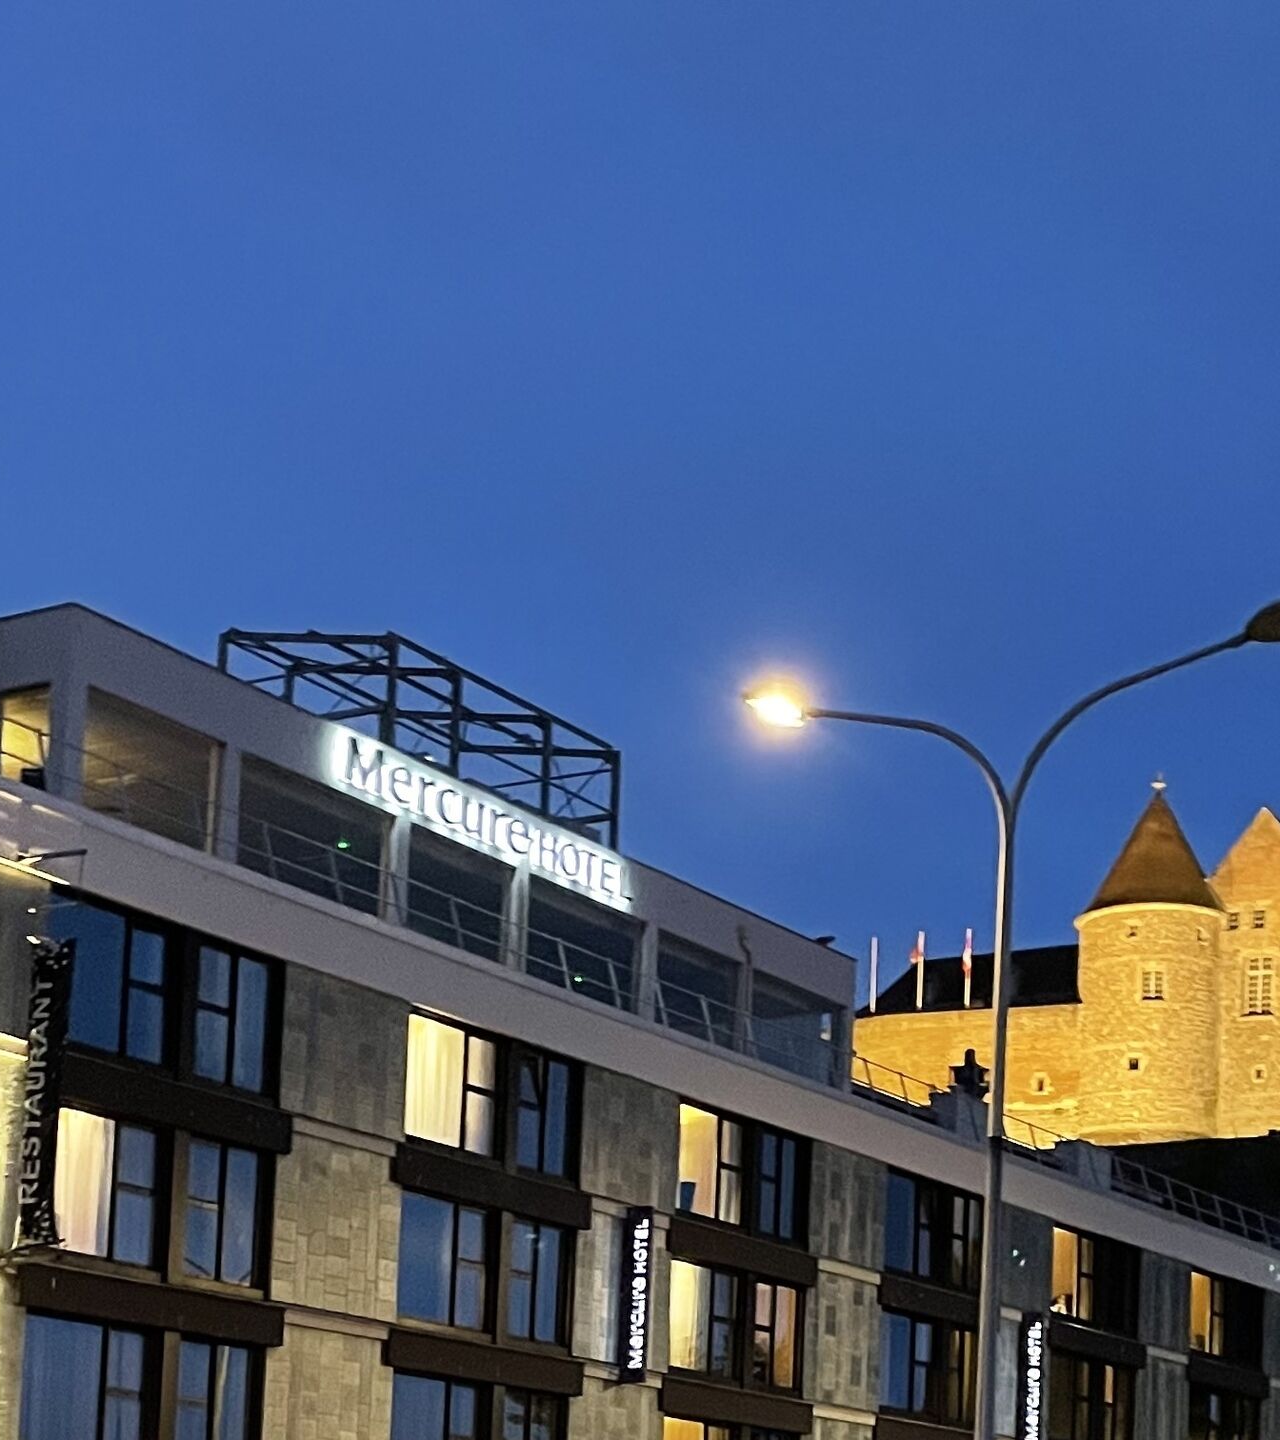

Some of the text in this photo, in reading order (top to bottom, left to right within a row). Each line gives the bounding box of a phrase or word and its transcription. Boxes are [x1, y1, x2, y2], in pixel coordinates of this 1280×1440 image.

[342, 736, 632, 901] Mercure HOTEL
[19, 979, 53, 1205] RESTAURANT
[627, 1218, 649, 1369] Mercure HOTEL
